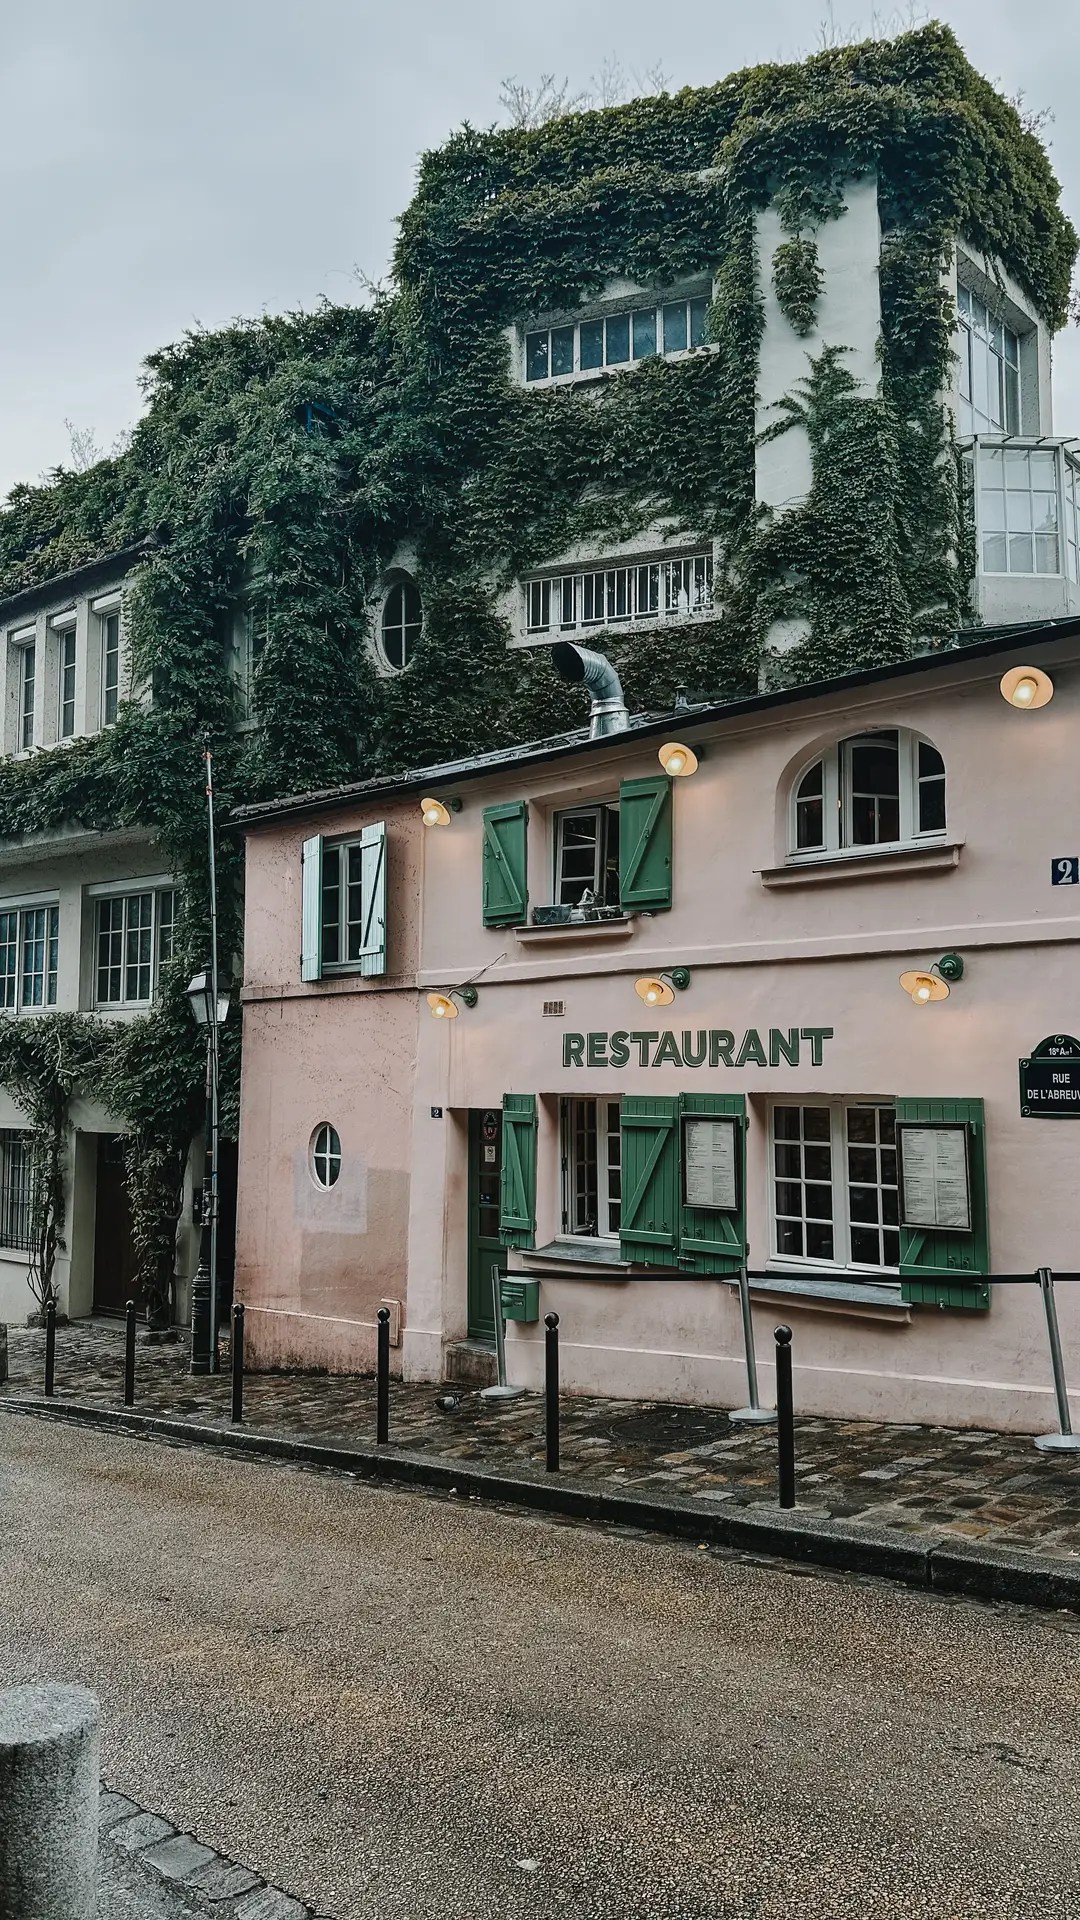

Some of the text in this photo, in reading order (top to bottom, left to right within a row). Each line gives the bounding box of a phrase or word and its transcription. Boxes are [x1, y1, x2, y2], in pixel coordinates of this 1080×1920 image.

[1057, 859, 1073, 884] 2
[562, 1027, 834, 1069] RESTAURANT
[1052, 1073, 1070, 1084] RUE
[1027, 1089, 1039, 1099] DE
